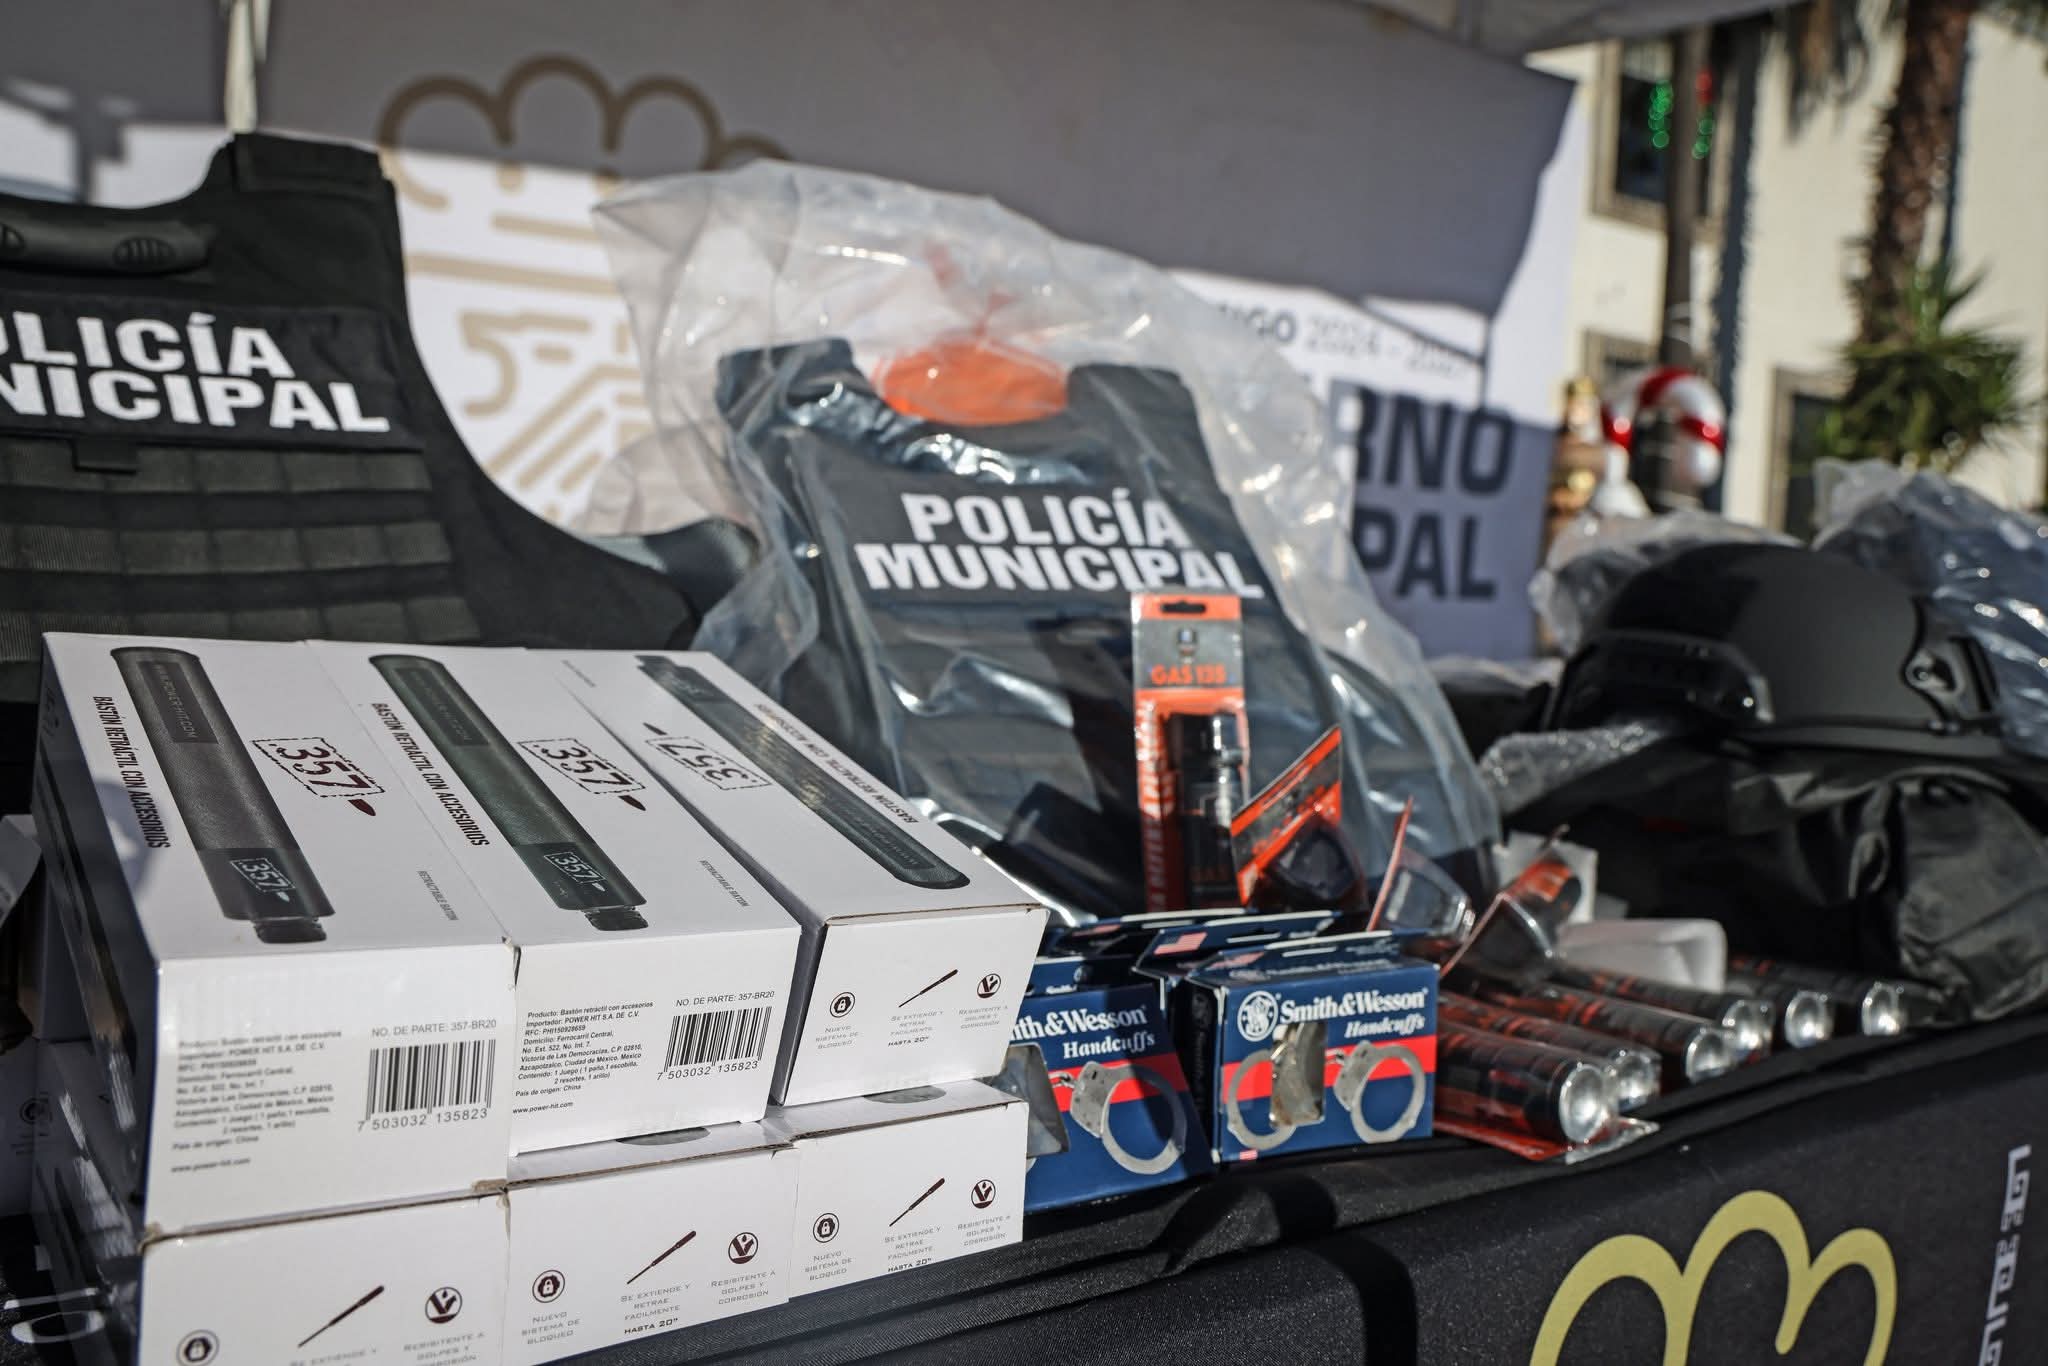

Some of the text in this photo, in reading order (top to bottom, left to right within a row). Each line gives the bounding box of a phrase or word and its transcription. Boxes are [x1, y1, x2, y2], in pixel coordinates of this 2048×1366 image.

[0, 311, 295, 378] LICÍA
[901, 488, 1192, 549] POLICÍA
[855, 543, 1264, 598] MUNICIPAL
[93, 696, 171, 849] BASTÓN RETRÁCTIL CON ACCESORIOS
[371, 702, 402, 731] BASTÓN
[422, 771, 449, 790] CON
[436, 789, 490, 847] ACCESORIOS
[693, 997, 705, 1005] DE
[707, 994, 736, 1003] PARTE:
[738, 990, 775, 1001] 357-BR20
[393, 1026, 408, 1036] DE
[411, 1022, 449, 1034] PARTE:
[451, 1019, 497, 1031] 357-BR20
[526, 1019, 563, 1028] Importador:
[564, 1015, 589, 1024] POWER
[627, 1010, 640, 1018] C.V.
[1344, 1013, 1426, 1038] Handcuffs
[1062, 1030, 1156, 1060] Handcuffs
[560, 1068, 579, 1077] Juego
[564, 1058, 587, 1067] Ciudad
[656, 1060, 758, 1081] 7 503032 135823
[512, 1101, 574, 1114] www.power-hit.com
[357, 1108, 488, 1132] 7 503032 135823
[624, 1323, 656, 1335] HASTA
